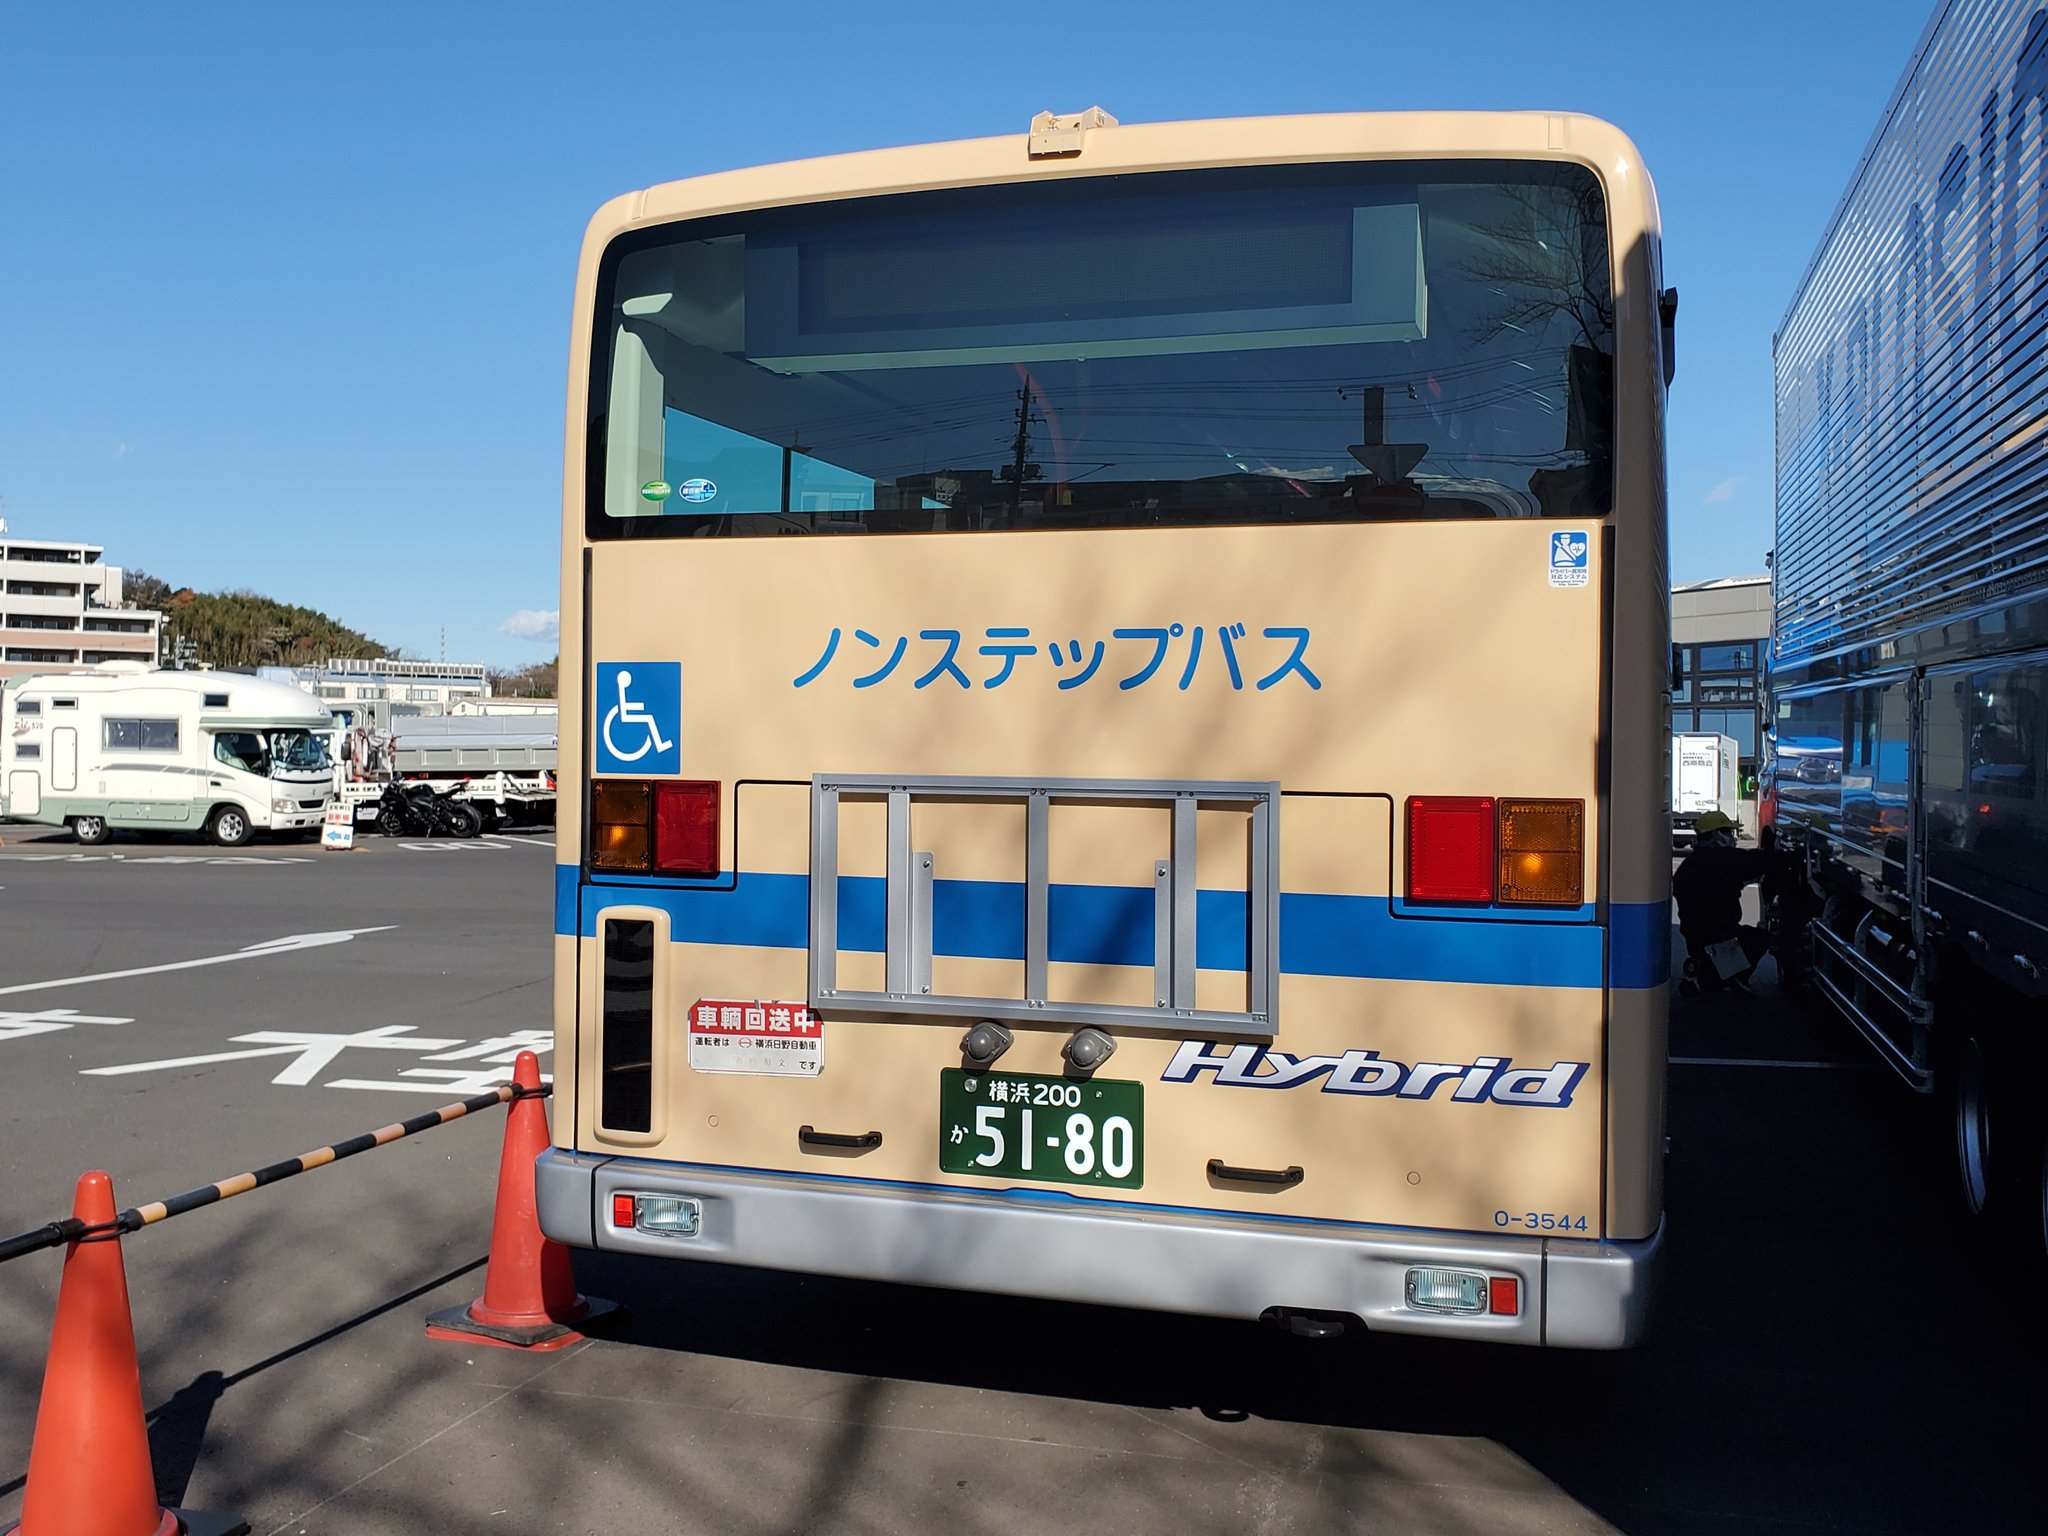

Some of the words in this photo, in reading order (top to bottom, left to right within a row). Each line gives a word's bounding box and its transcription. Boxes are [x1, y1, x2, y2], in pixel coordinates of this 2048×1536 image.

[793, 622, 1322, 691] ノンステップバス
[755, 1039, 817, 1050] 横浜日野自動車
[799, 1061, 817, 1071] です
[1160, 1039, 1591, 1109] Hybrid
[950, 1124, 970, 1145] か
[975, 1105, 1134, 1179] 51-80
